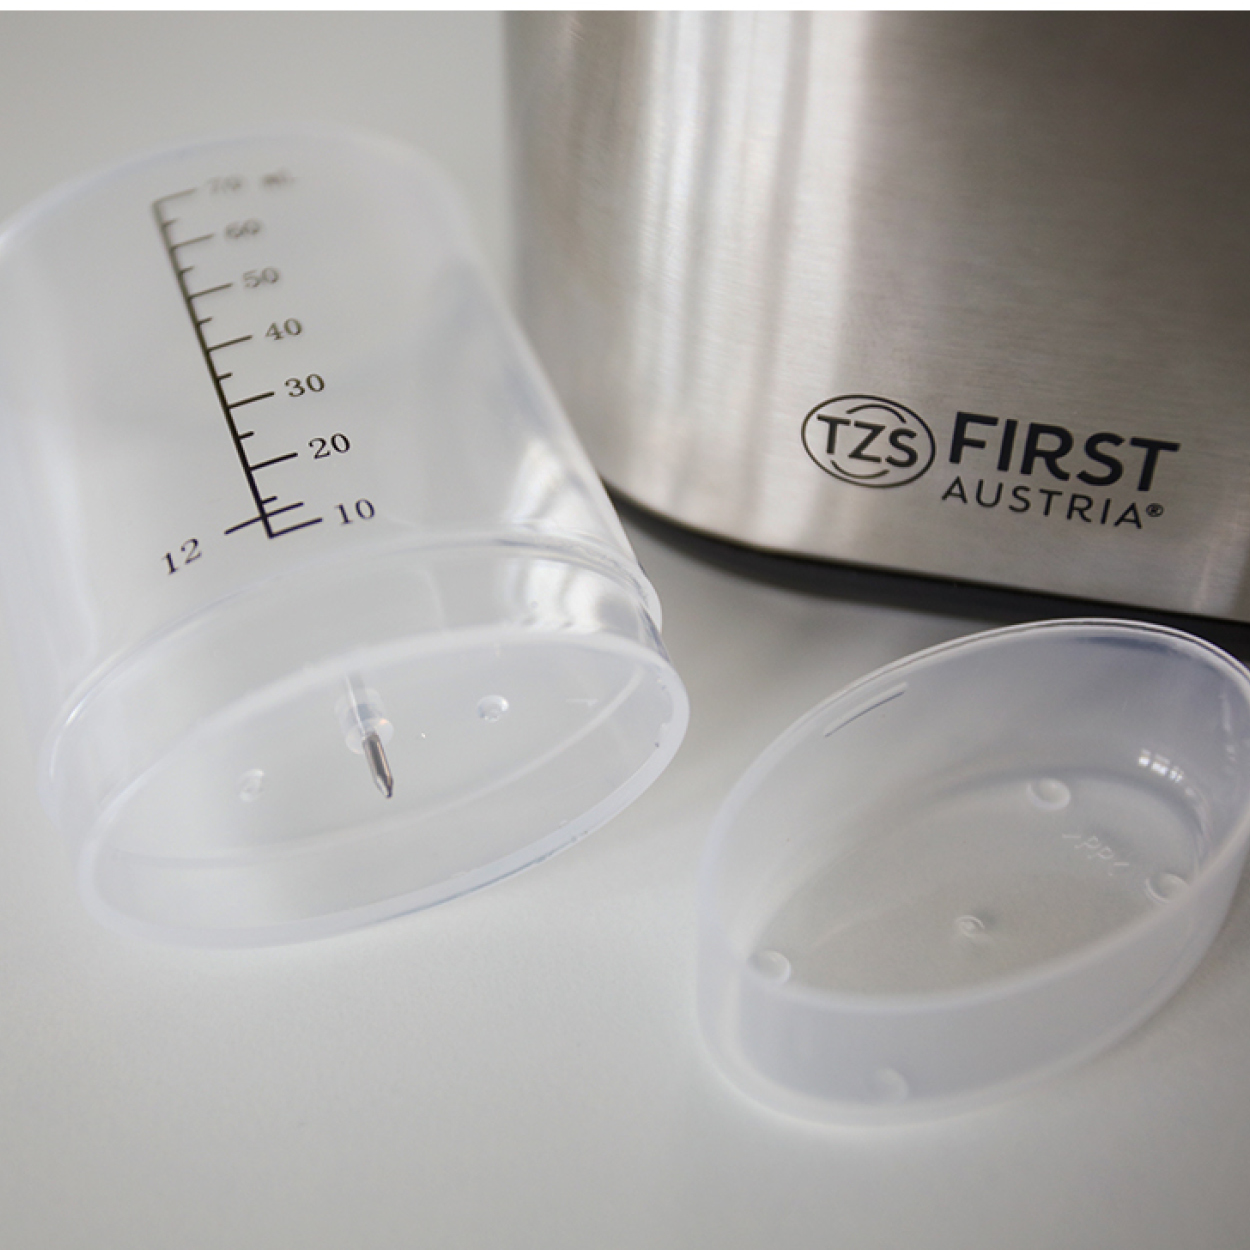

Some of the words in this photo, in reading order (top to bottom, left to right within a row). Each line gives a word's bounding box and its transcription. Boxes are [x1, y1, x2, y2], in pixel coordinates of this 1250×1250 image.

[224, 218, 262, 239] 60
[242, 266, 281, 289] 50
[264, 317, 303, 341] 40
[284, 373, 326, 398] 30
[308, 432, 351, 460] 20
[816, 413, 919, 469] TZS
[948, 410, 1181, 493] FIRST
[334, 497, 376, 526] 10
[161, 537, 203, 576] 12
